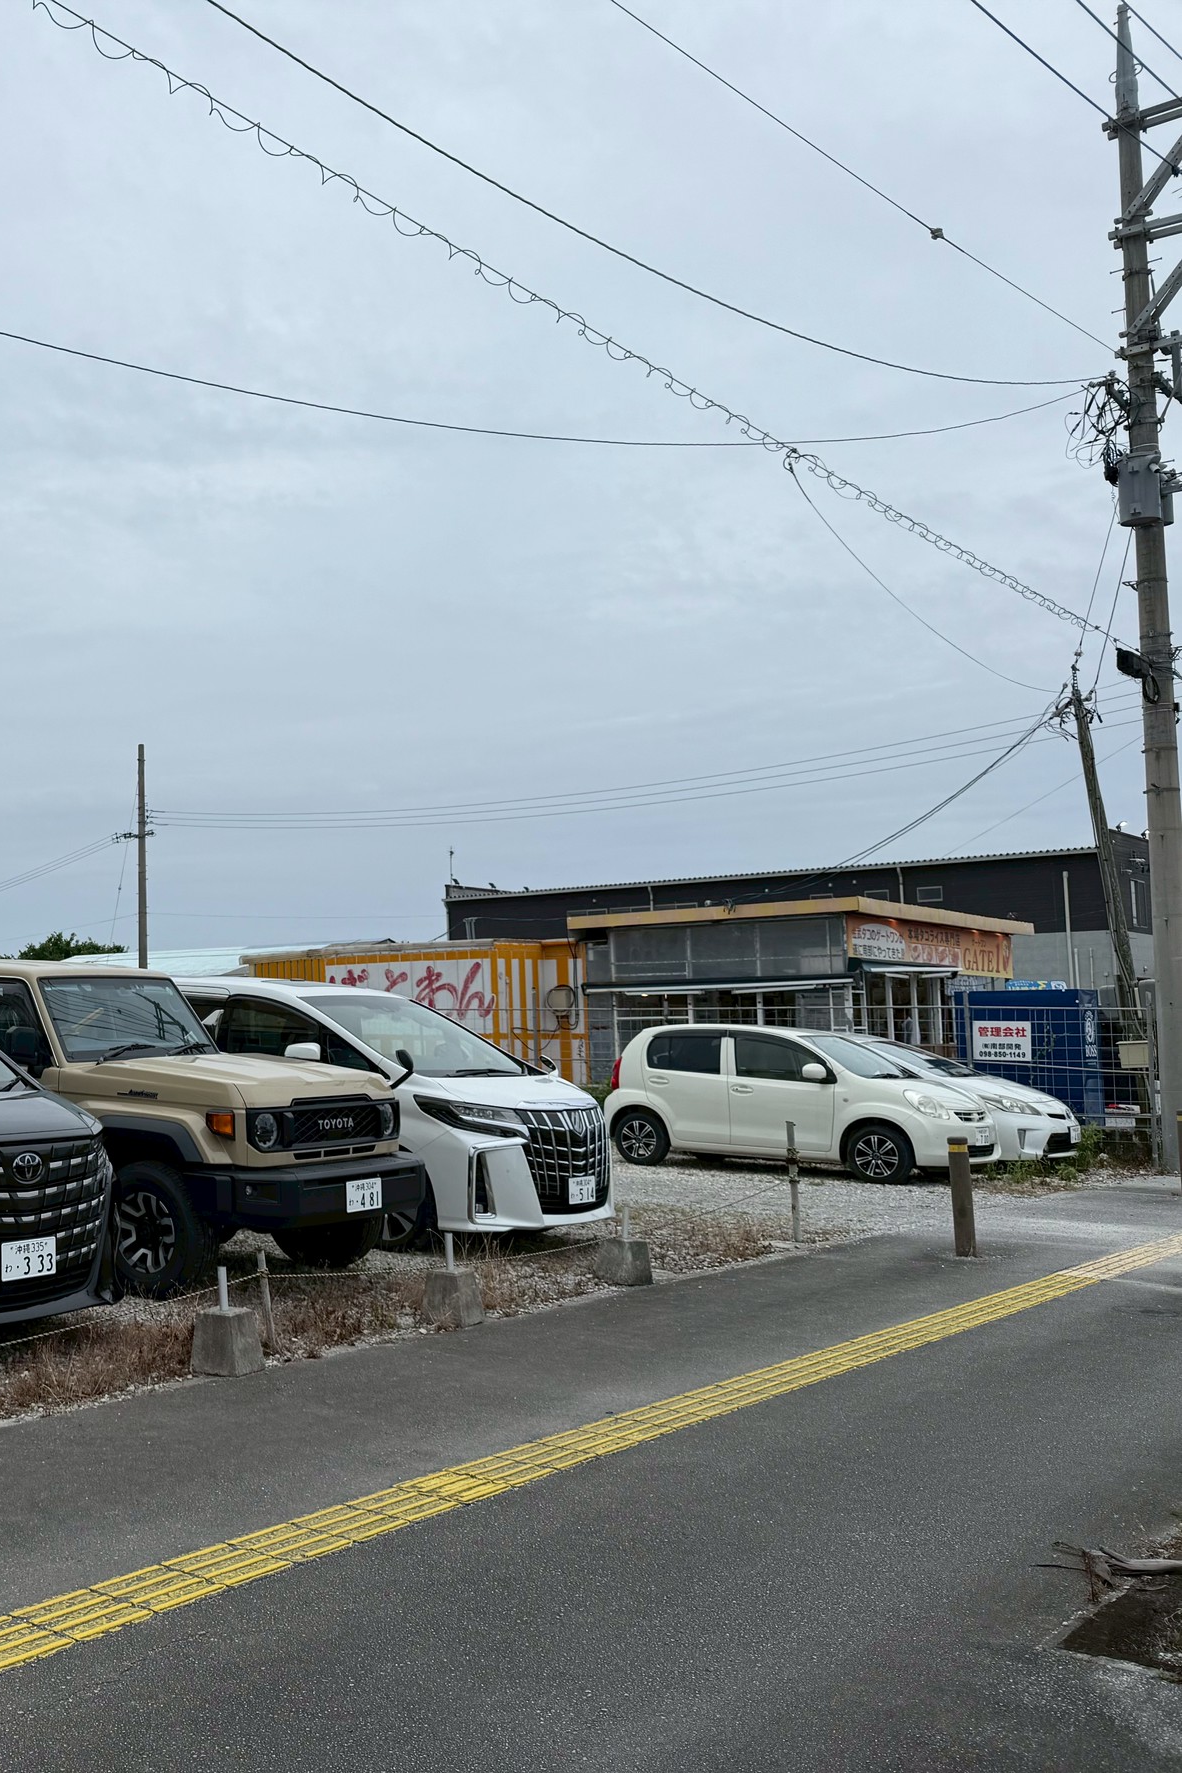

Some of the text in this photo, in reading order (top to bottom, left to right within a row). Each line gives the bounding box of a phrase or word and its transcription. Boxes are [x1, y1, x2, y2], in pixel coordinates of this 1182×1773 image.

[978, 1026, 1027, 1038] 管理会社
[978, 1050, 1026, 1059] 098-850-1149
[318, 1117, 355, 1130] TOYOTA
[15, 1241, 45, 1255] 沖縄335
